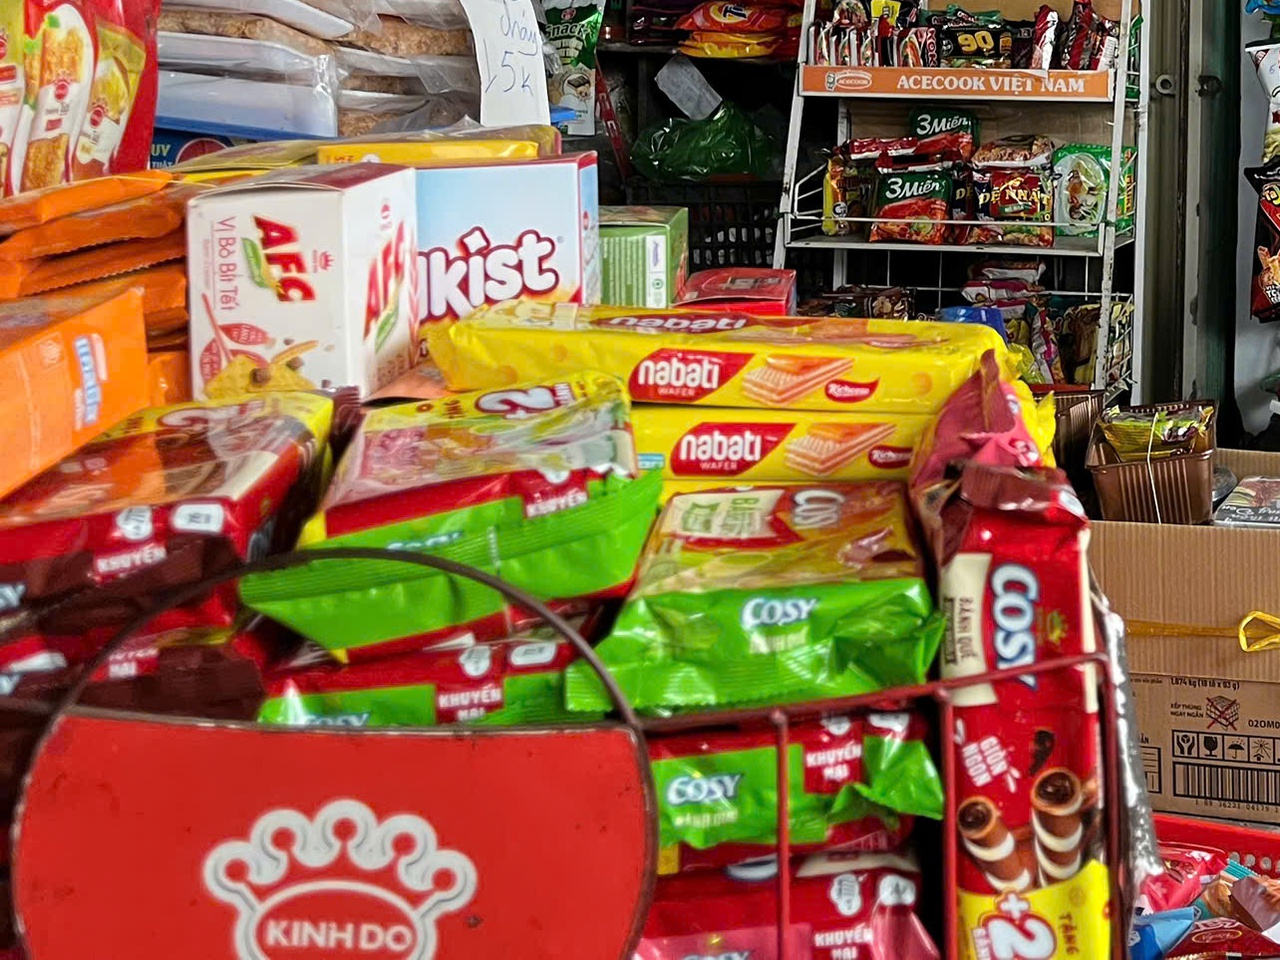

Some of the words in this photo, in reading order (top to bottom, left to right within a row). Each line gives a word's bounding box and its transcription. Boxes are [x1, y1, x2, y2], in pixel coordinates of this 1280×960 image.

[958, 31, 994, 54] 90
[898, 76, 986, 90] ACECOOK
[994, 74, 1033, 95] VIỆT
[1041, 78, 1085, 92] NAM
[253, 213, 316, 303] AFC
[418, 227, 560, 323] kist
[609, 316, 748, 332] nabati
[638, 355, 720, 390] nabati
[657, 386, 697, 398] WAFER
[679, 430, 763, 462] nabati
[700, 461, 738, 473] WAFER
[741, 596, 819, 630] COSY
[438, 683, 502, 709] KHUYẾN
[805, 741, 862, 769] KHUYẾN
[962, 740, 992, 788] NGON
[666, 772, 744, 806] COSY
[265, 919, 354, 951] KINH
[814, 924, 873, 947] KHUYẾN
